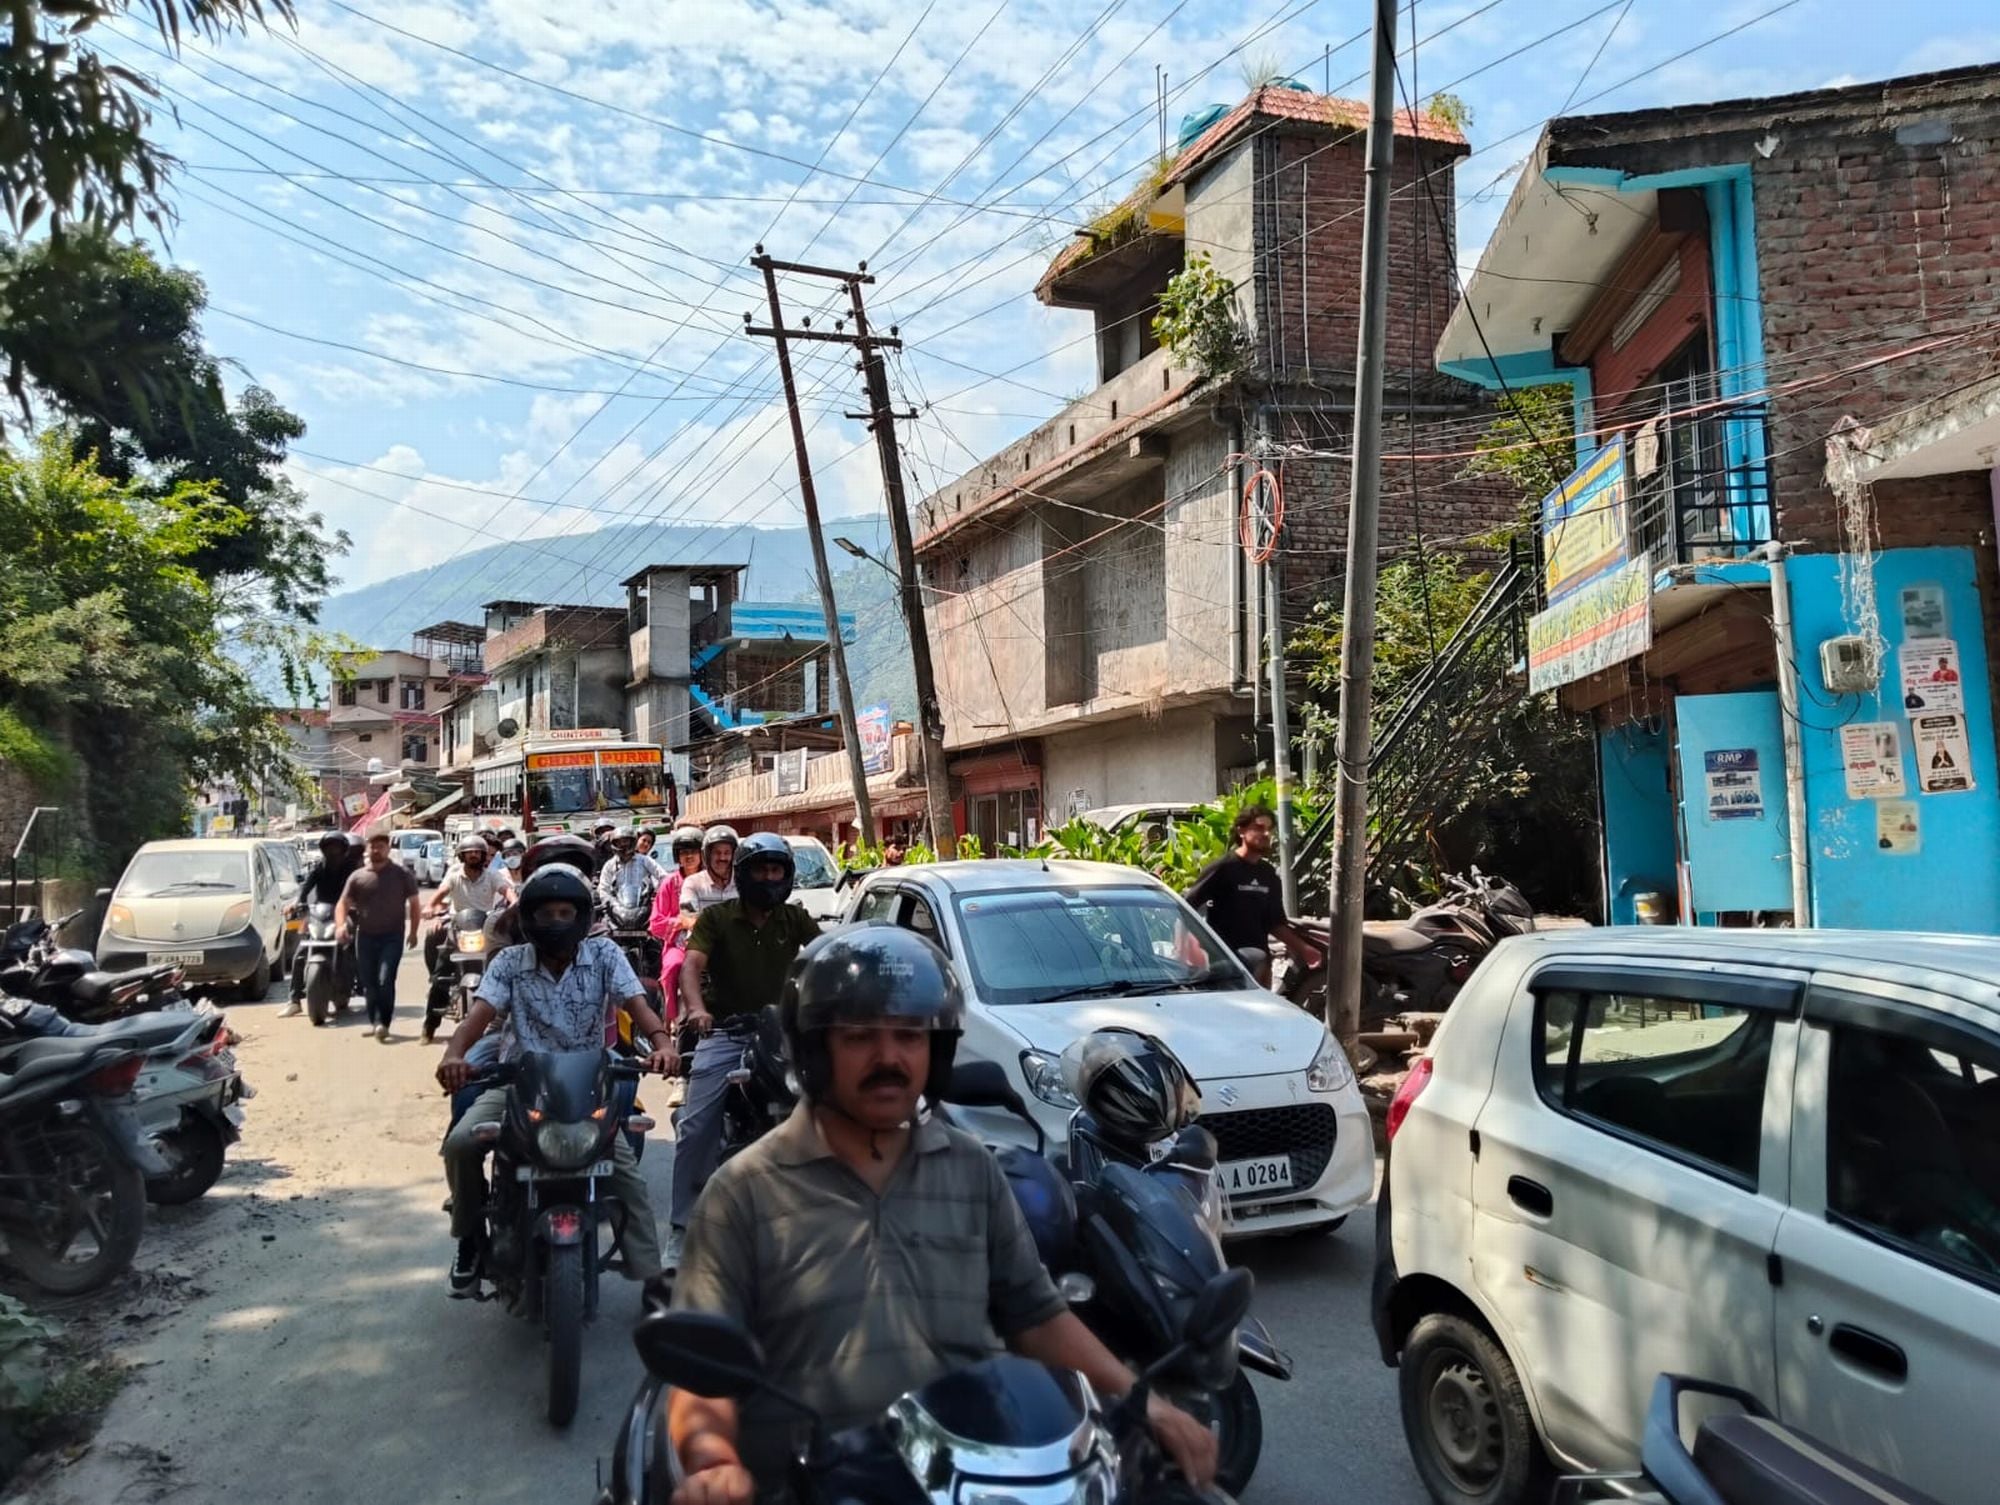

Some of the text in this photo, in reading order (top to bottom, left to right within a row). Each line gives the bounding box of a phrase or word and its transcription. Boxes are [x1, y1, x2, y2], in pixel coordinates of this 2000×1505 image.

[601, 751, 654, 764] PURNI
[1717, 753, 1743, 763] RMP
[1233, 1167, 1242, 1188] A
[1247, 1162, 1289, 1186] 0284
